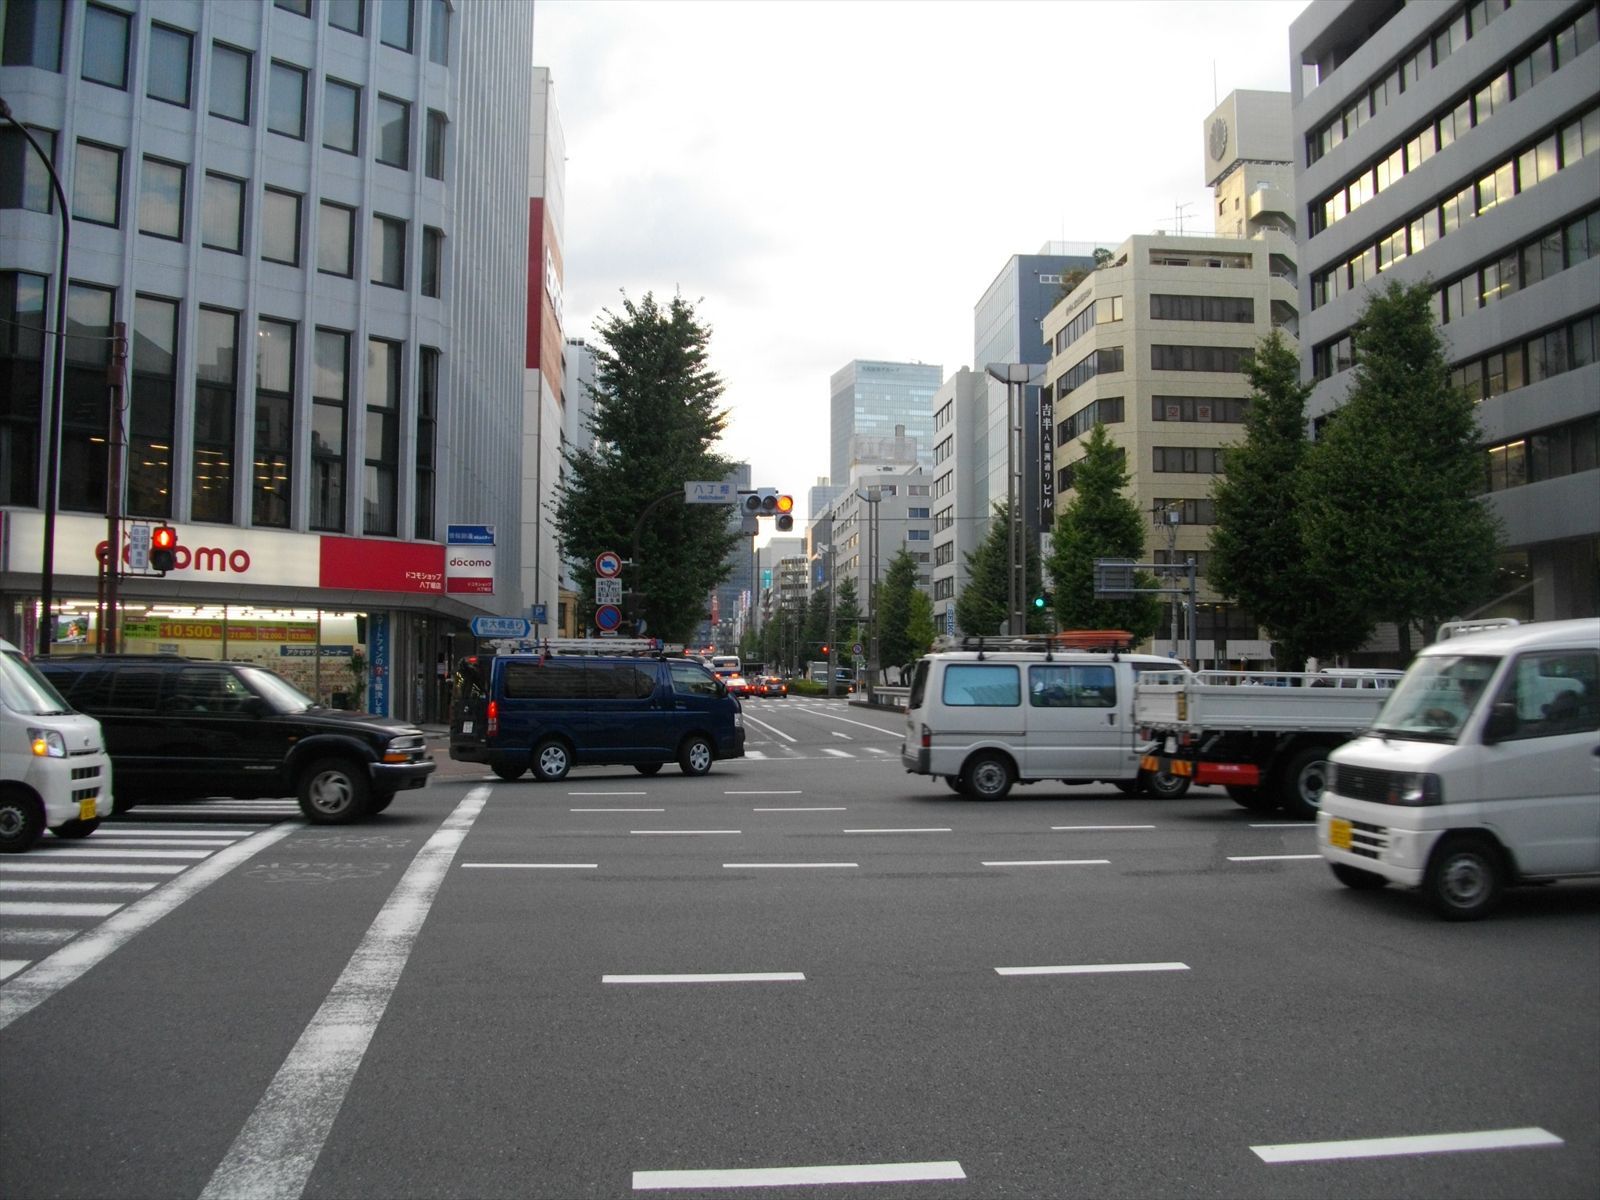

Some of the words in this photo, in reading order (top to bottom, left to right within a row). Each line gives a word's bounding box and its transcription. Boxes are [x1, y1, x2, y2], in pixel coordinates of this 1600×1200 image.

[450, 557, 491, 567] docomo
[405, 571, 442, 580] ドコモショップ
